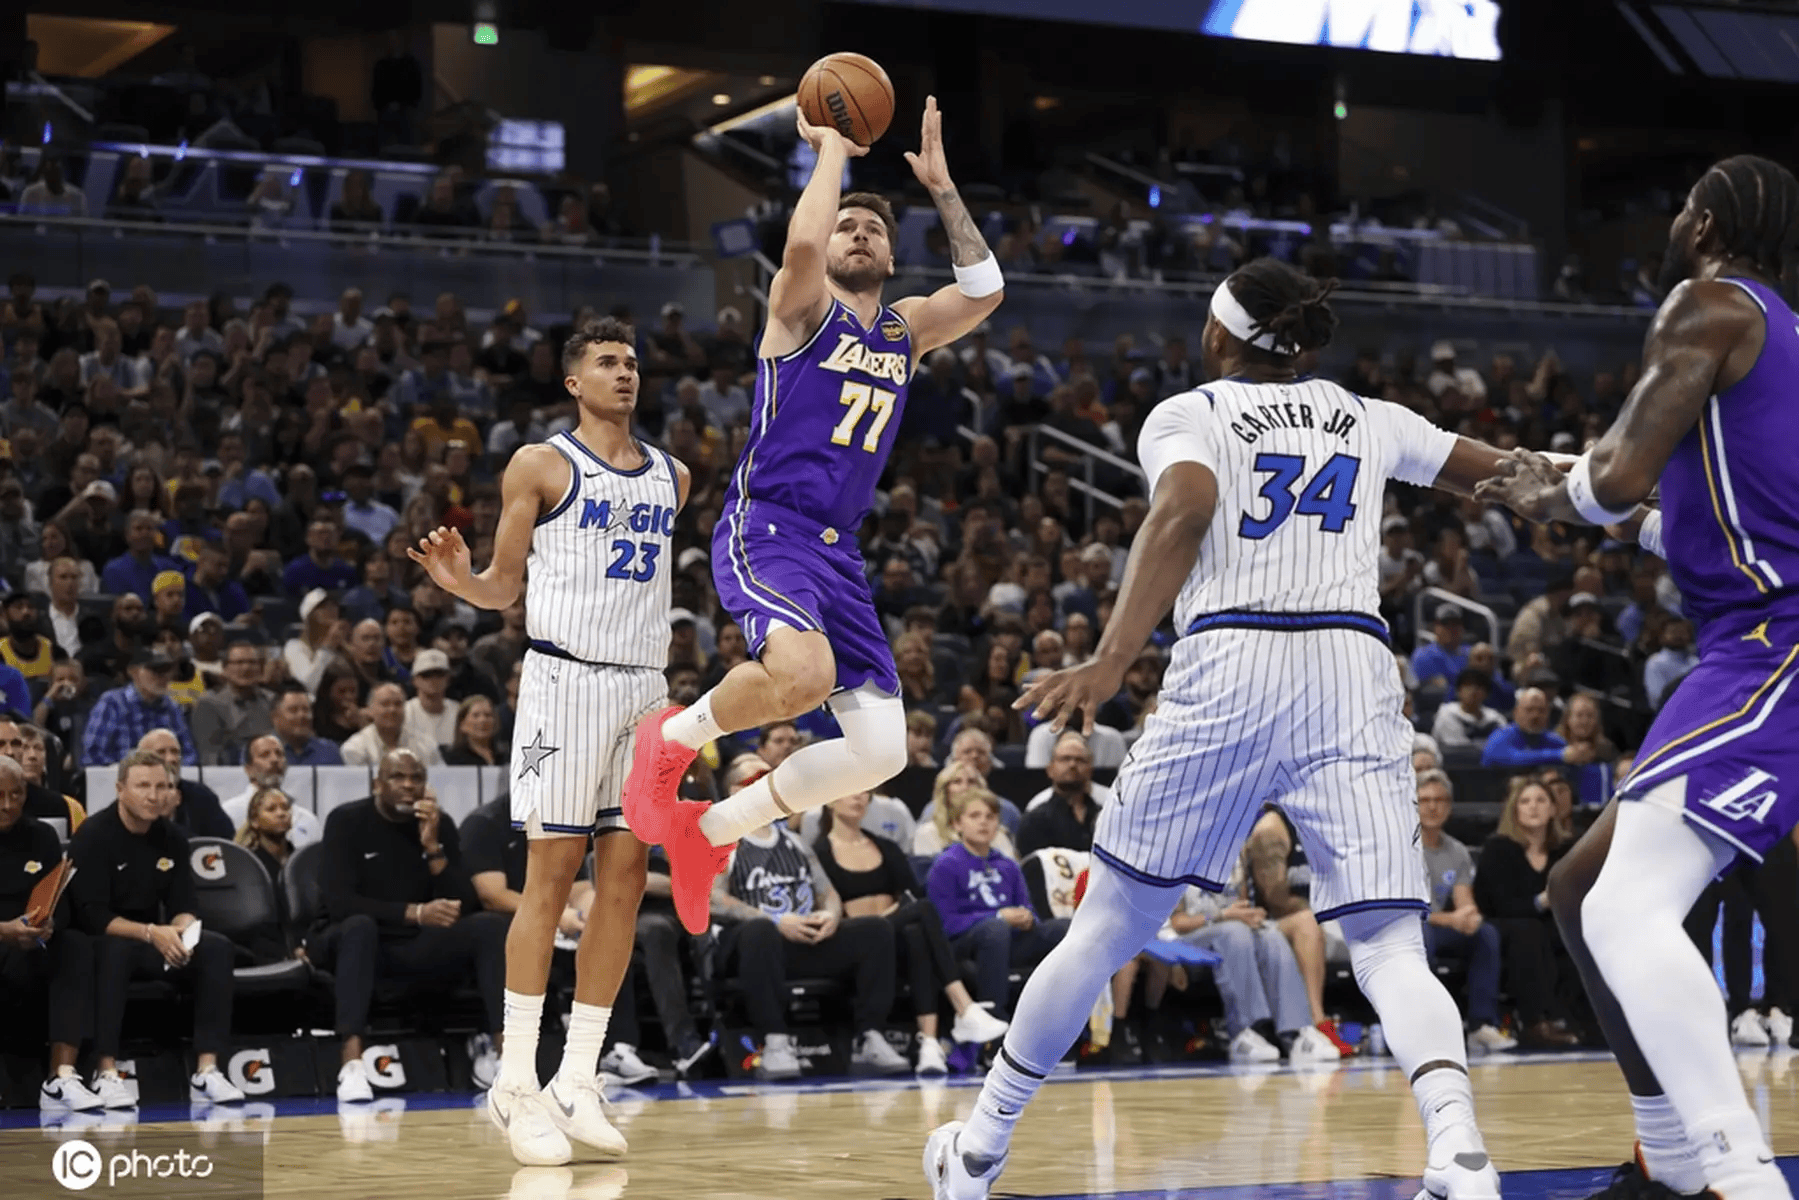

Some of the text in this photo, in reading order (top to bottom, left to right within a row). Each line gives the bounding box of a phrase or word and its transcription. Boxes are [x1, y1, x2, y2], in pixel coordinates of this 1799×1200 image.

[818, 332, 907, 386] LAKERS
[830, 379, 897, 454] 77
[1231, 403, 1356, 444] CARTER JR.
[1238, 452, 1361, 540] 34
[605, 539, 661, 582] 23
[1698, 766, 1779, 824] LA
[190, 845, 227, 880] G
[228, 1044, 407, 1095] G G
